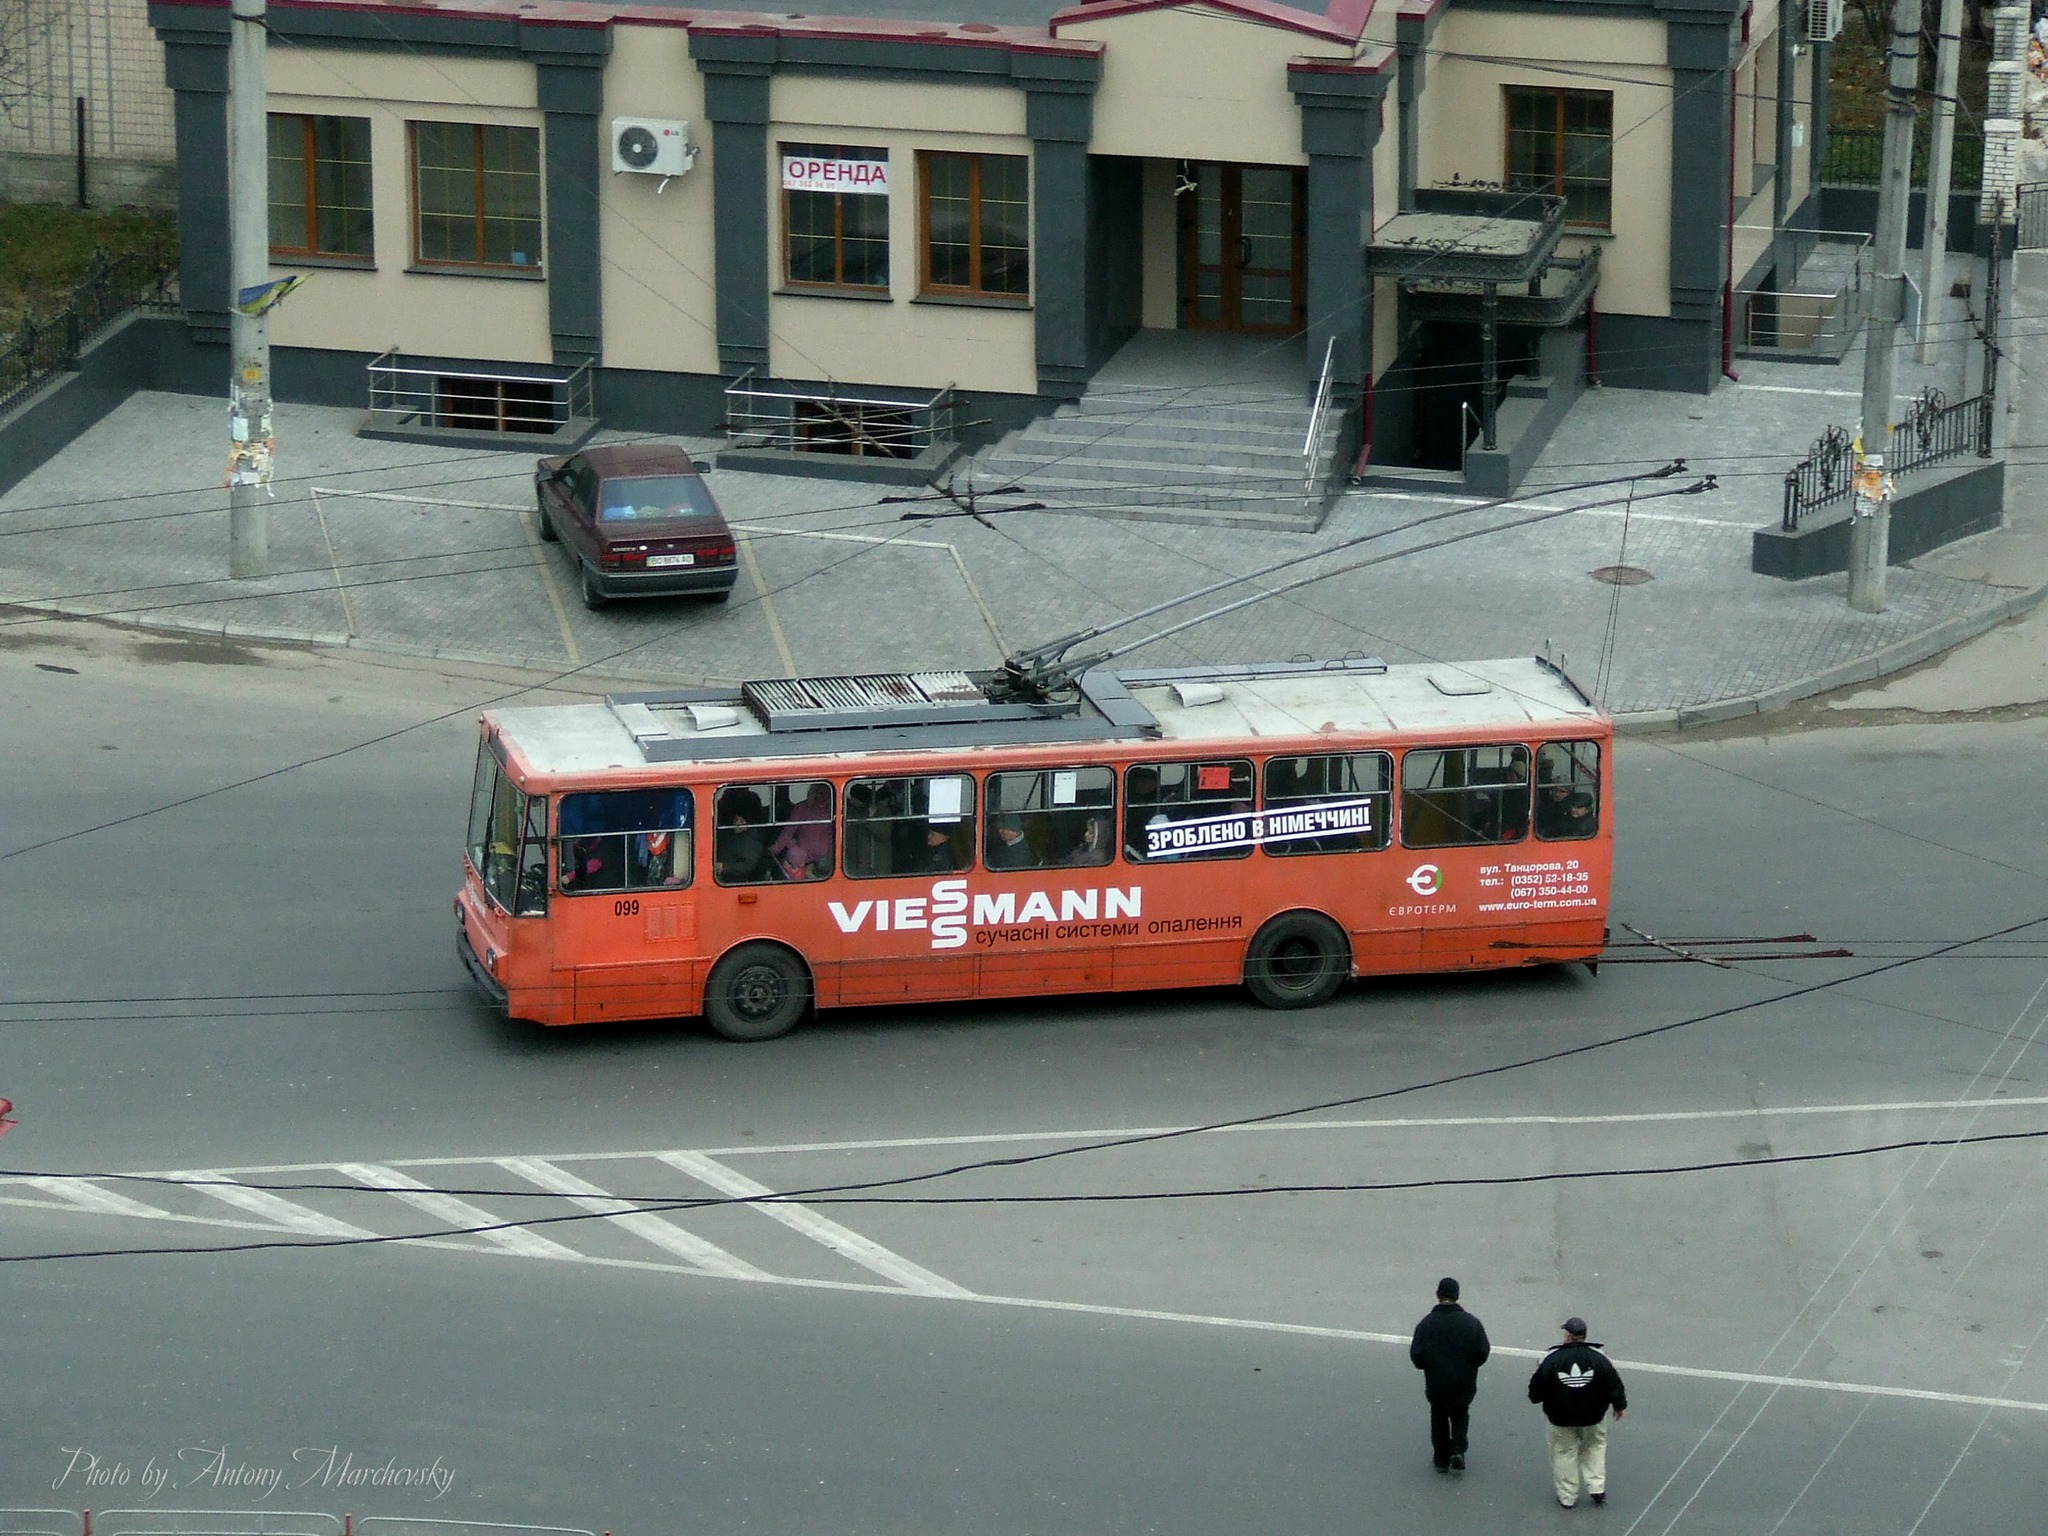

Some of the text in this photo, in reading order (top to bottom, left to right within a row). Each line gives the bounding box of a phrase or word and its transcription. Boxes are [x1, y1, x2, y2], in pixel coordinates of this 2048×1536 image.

[788, 161, 887, 185] ОРЕНДА
[1148, 806, 1370, 850] ЗРОБЛЕНО В НІМЕЧЧИНІ
[1480, 860, 1579, 875] вул. Танцорова, 20
[1511, 875, 1543, 887] (0352)
[1545, 872, 1589, 883] 52-18-35
[1510, 884, 1588, 899] (067) 350-44-00
[615, 900, 639, 916] 099
[1389, 904, 1456, 916] ЄВРОТЕРМ
[1479, 898, 1597, 911] www.euro-term.com.ua
[827, 880, 1142, 949] VIESSMANN
[975, 915, 1242, 947] сучасні системи опалення
